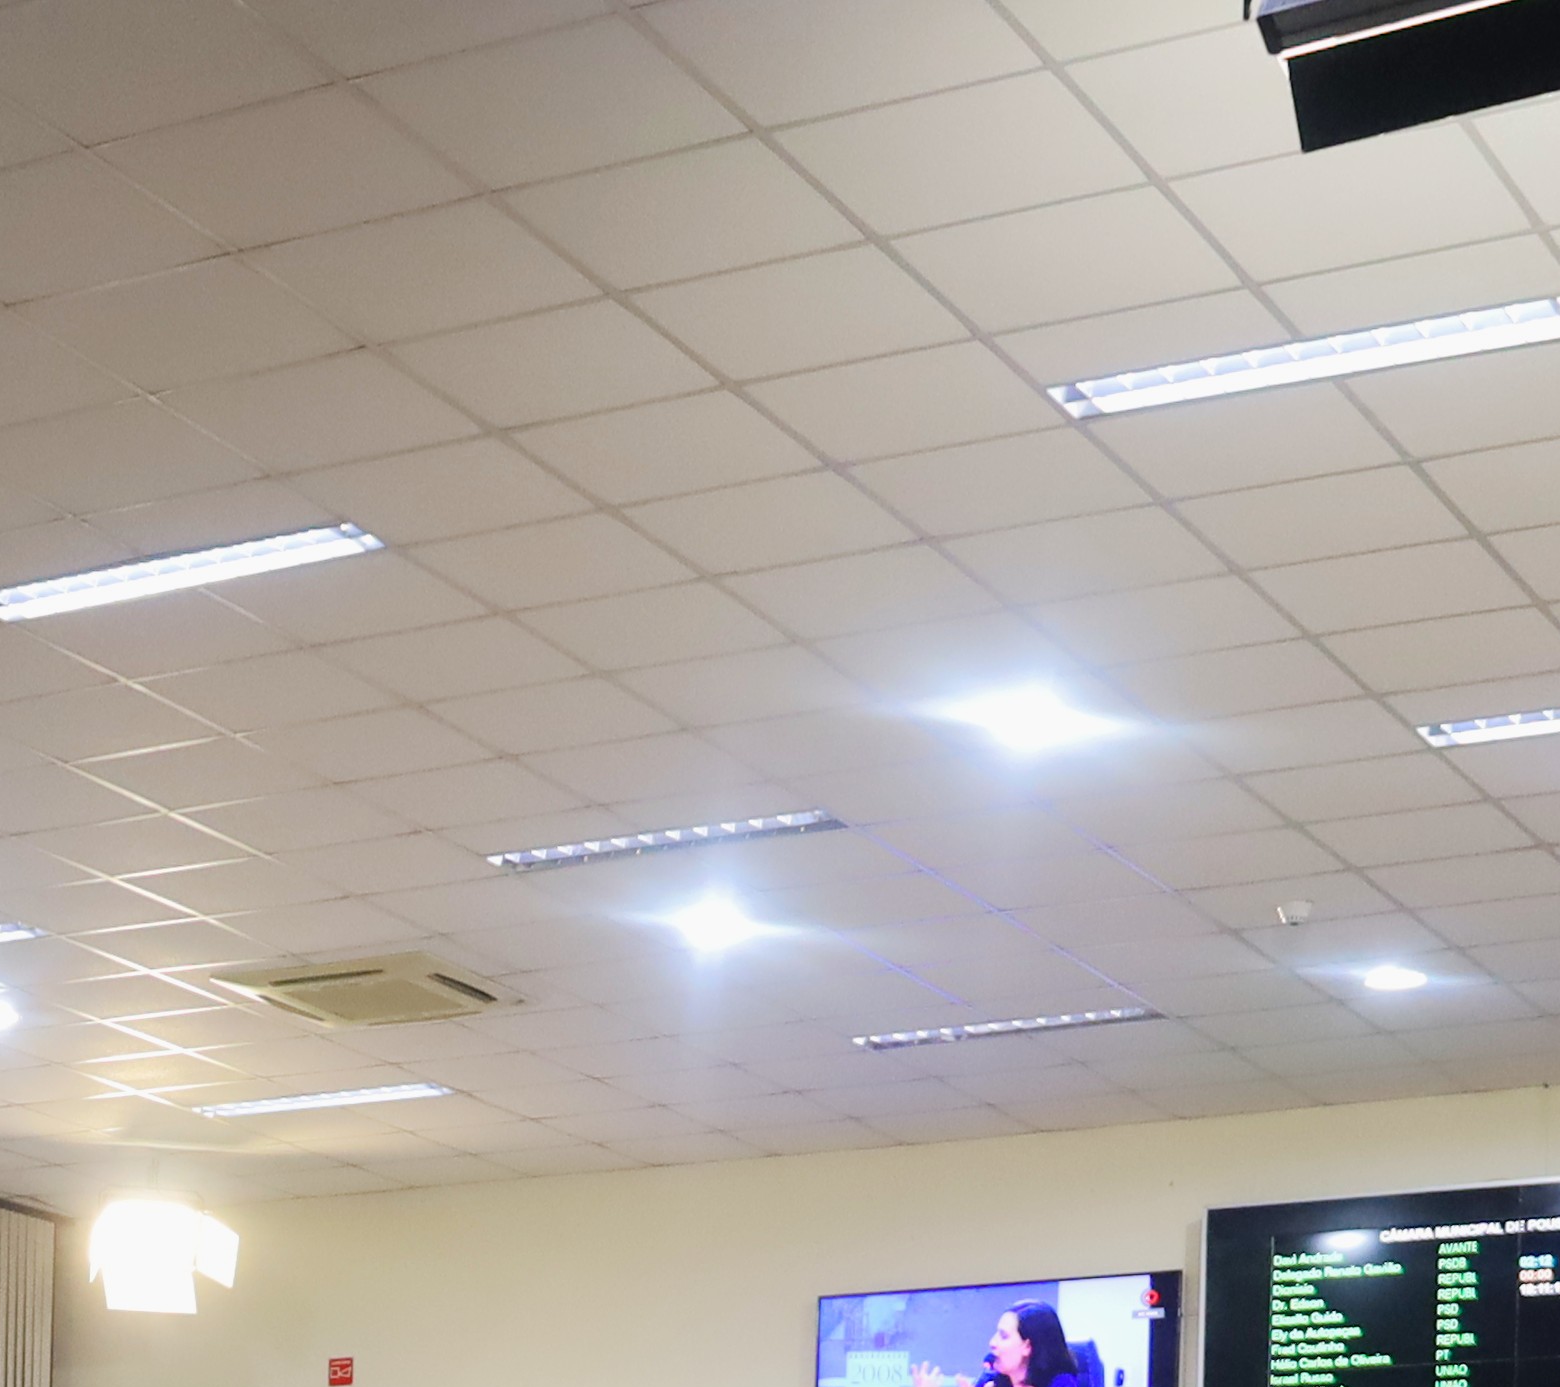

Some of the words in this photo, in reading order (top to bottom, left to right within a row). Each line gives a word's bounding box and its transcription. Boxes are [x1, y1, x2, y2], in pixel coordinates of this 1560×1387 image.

[1435, 1220, 1504, 1239] MUNICIPAL
[1505, 1220, 1525, 1234] DE
[1438, 1241, 1478, 1255] AVANTE
[1438, 1257, 1468, 1270] PSDB
[1436, 1303, 1460, 1316] PSD
[1436, 1318, 1460, 1332] PSD
[1435, 1349, 1451, 1361] PT
[851, 1364, 902, 1385] 2008
